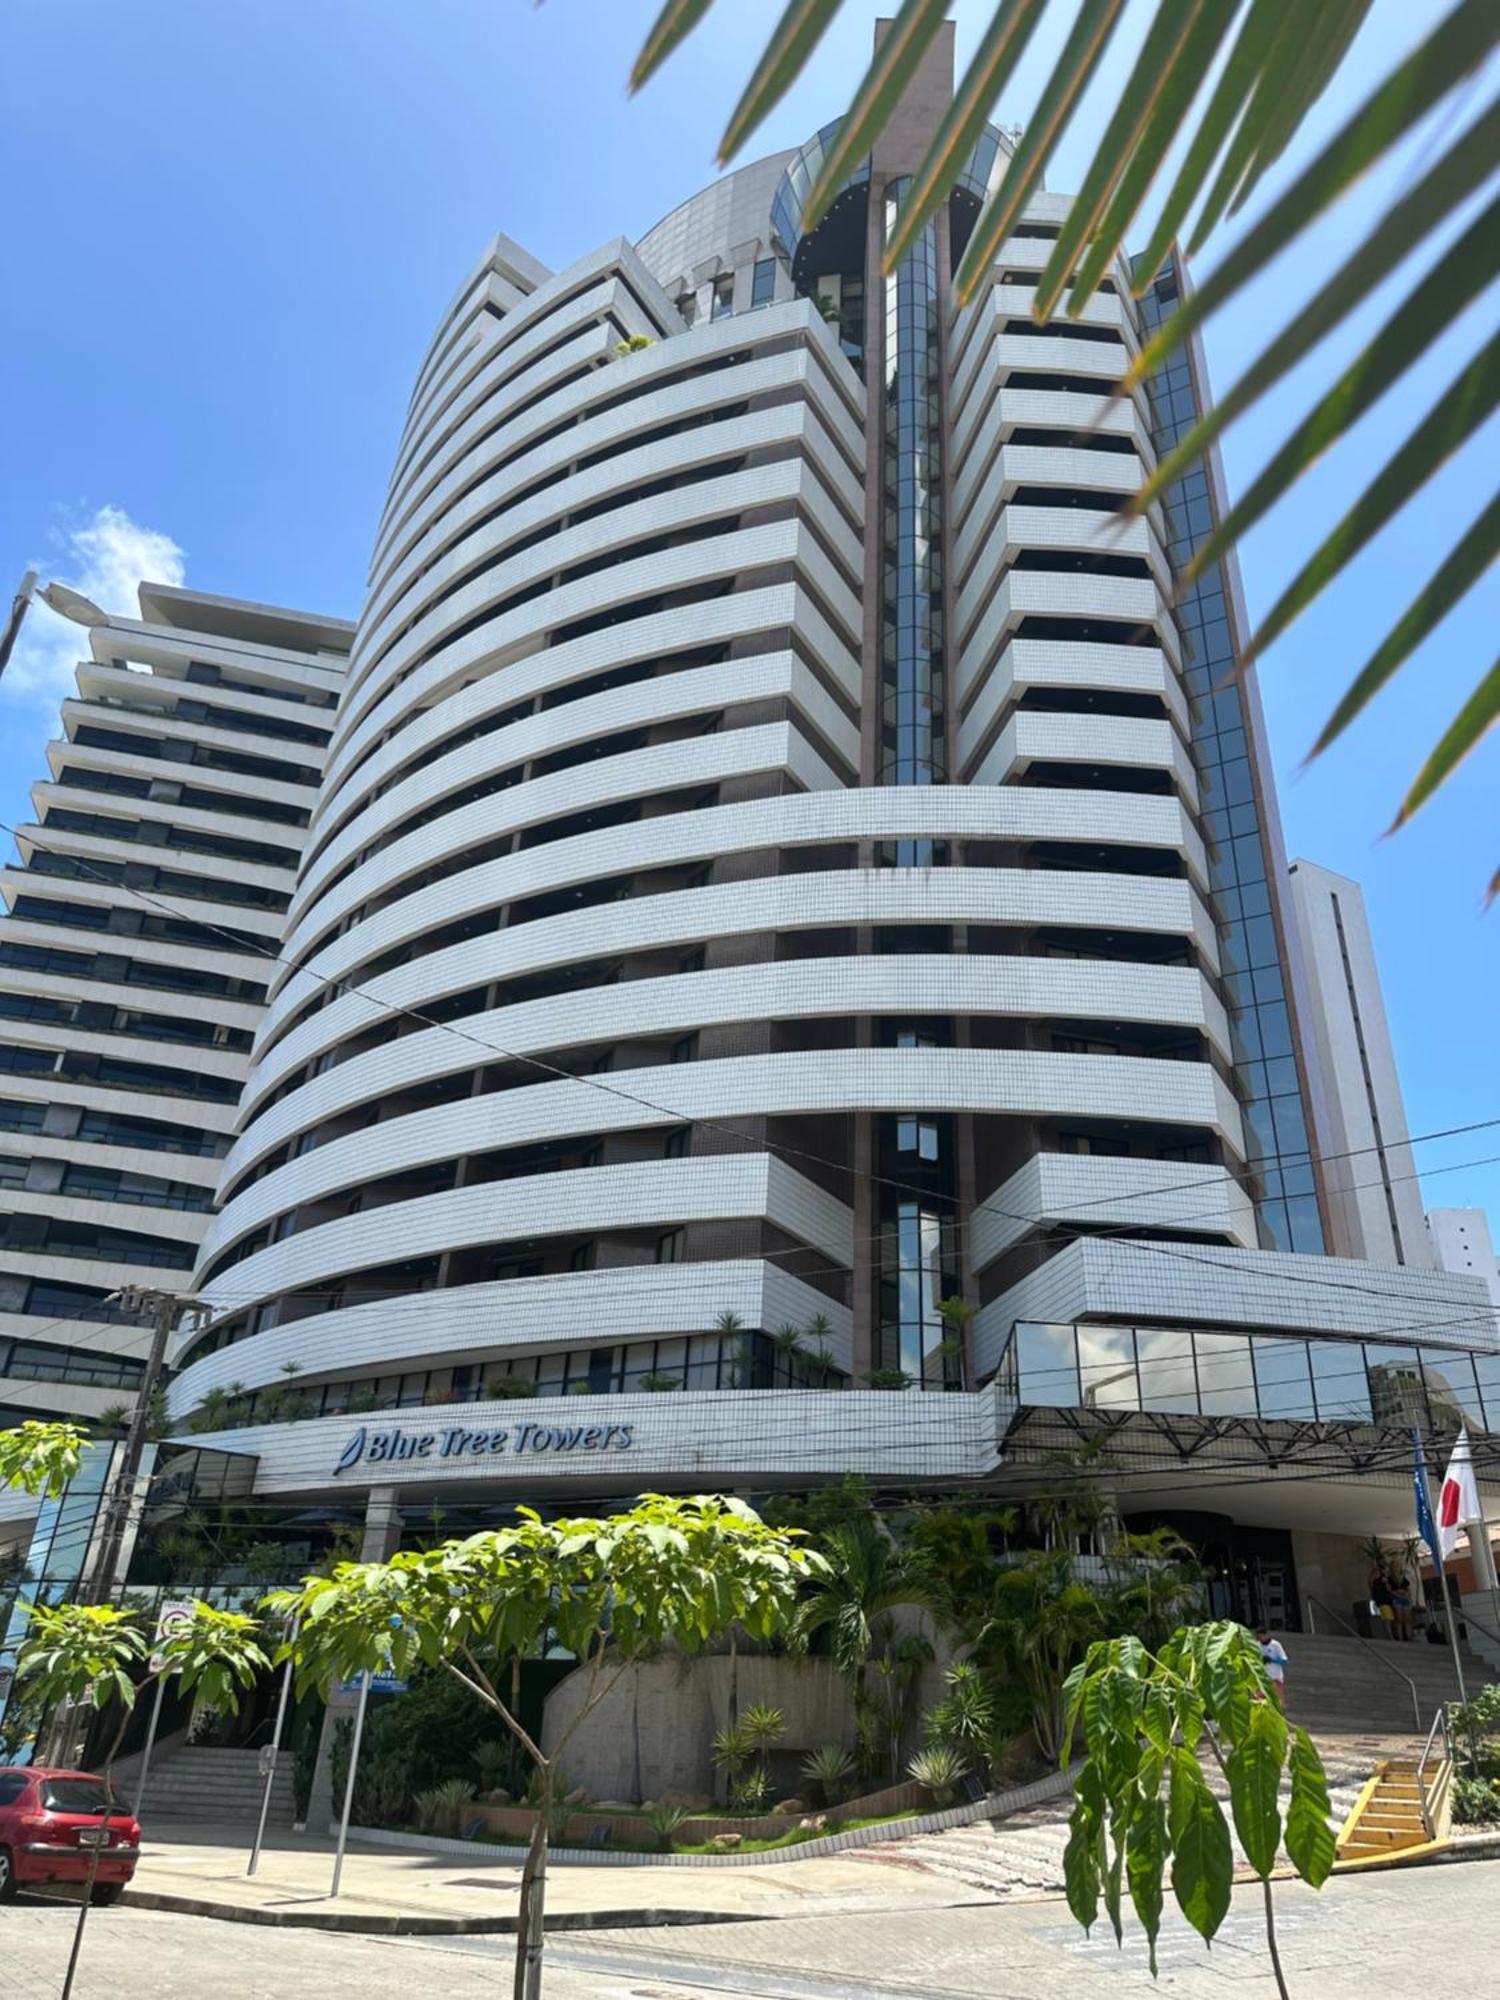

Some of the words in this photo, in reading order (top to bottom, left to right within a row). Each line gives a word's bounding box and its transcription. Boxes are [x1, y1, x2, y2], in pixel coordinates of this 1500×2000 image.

[364, 1429, 434, 1462] Blue
[439, 1427, 508, 1457] Tree
[513, 1421, 633, 1453] Towers
